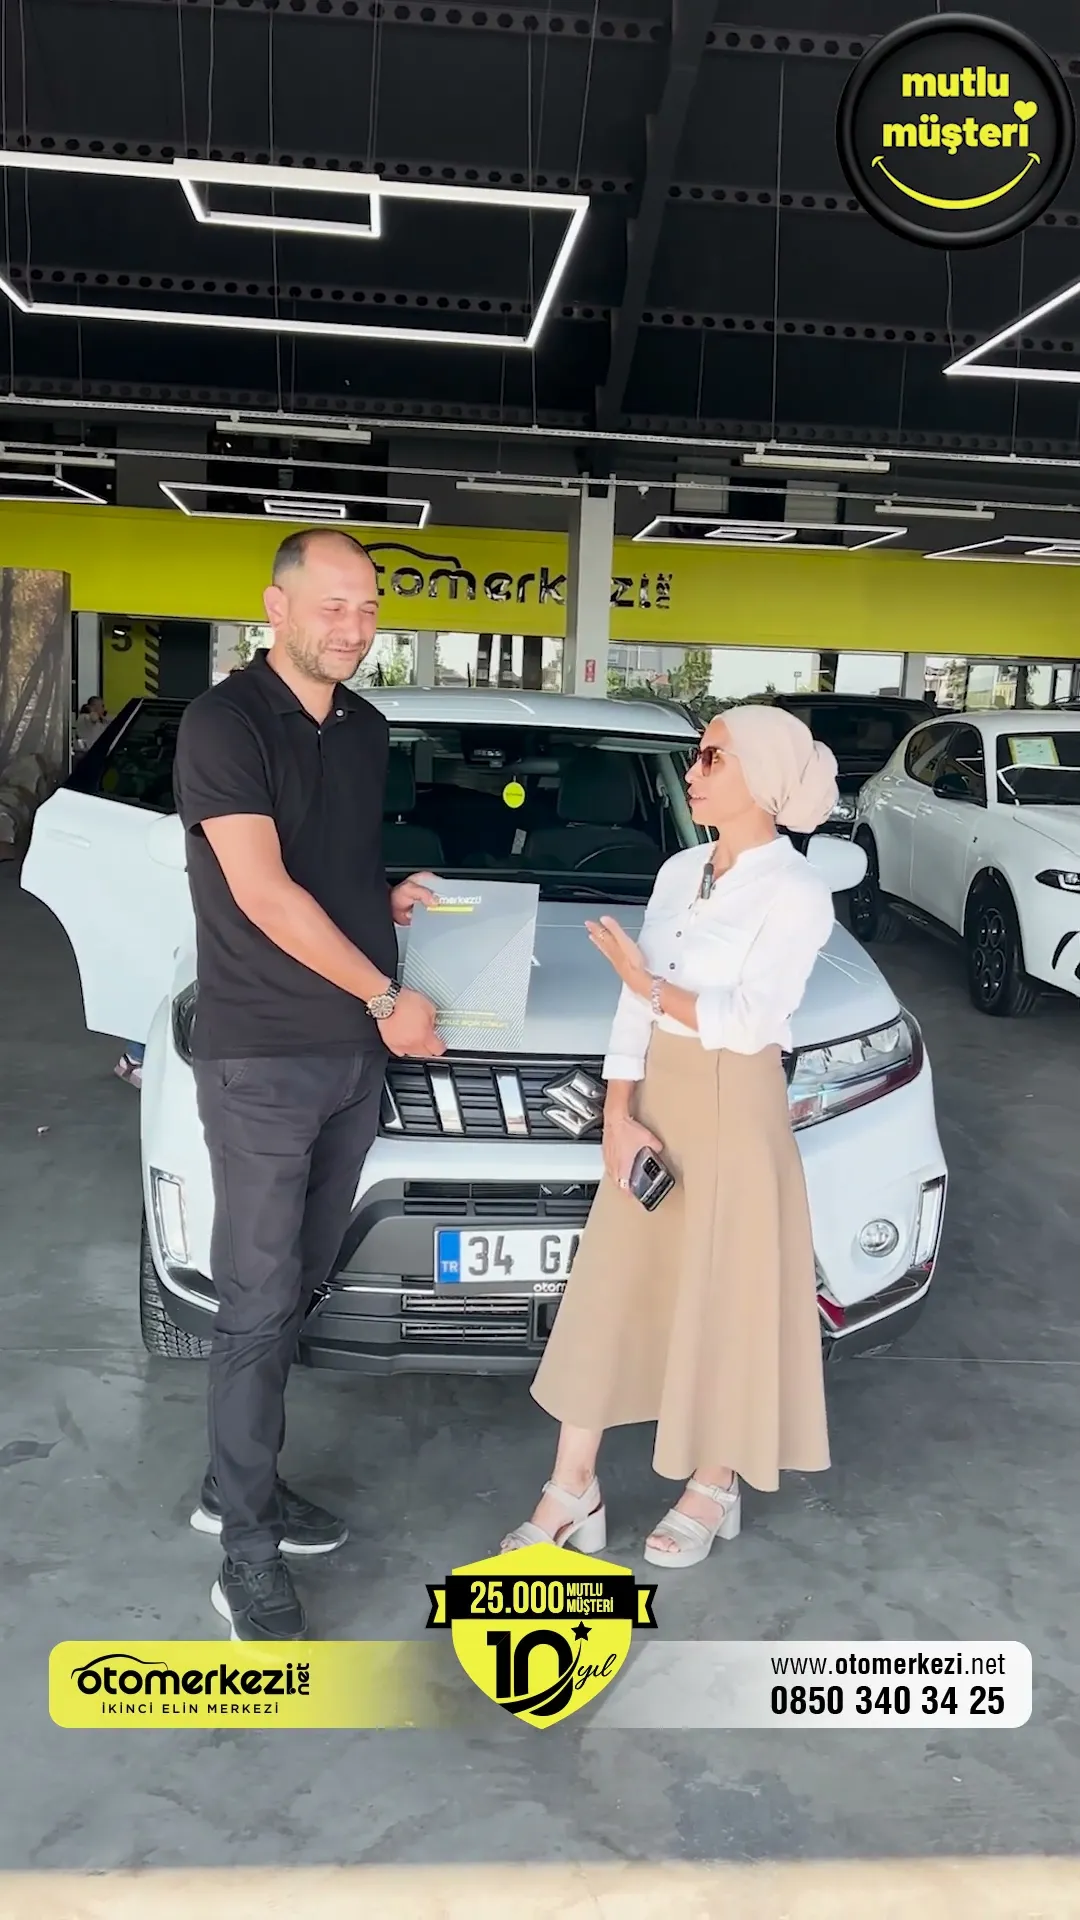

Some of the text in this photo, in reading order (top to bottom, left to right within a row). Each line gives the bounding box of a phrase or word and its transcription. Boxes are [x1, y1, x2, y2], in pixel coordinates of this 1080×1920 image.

[111, 624, 132, 652] 5
[441, 1261, 459, 1273] TR
[468, 1235, 515, 1276] 34
